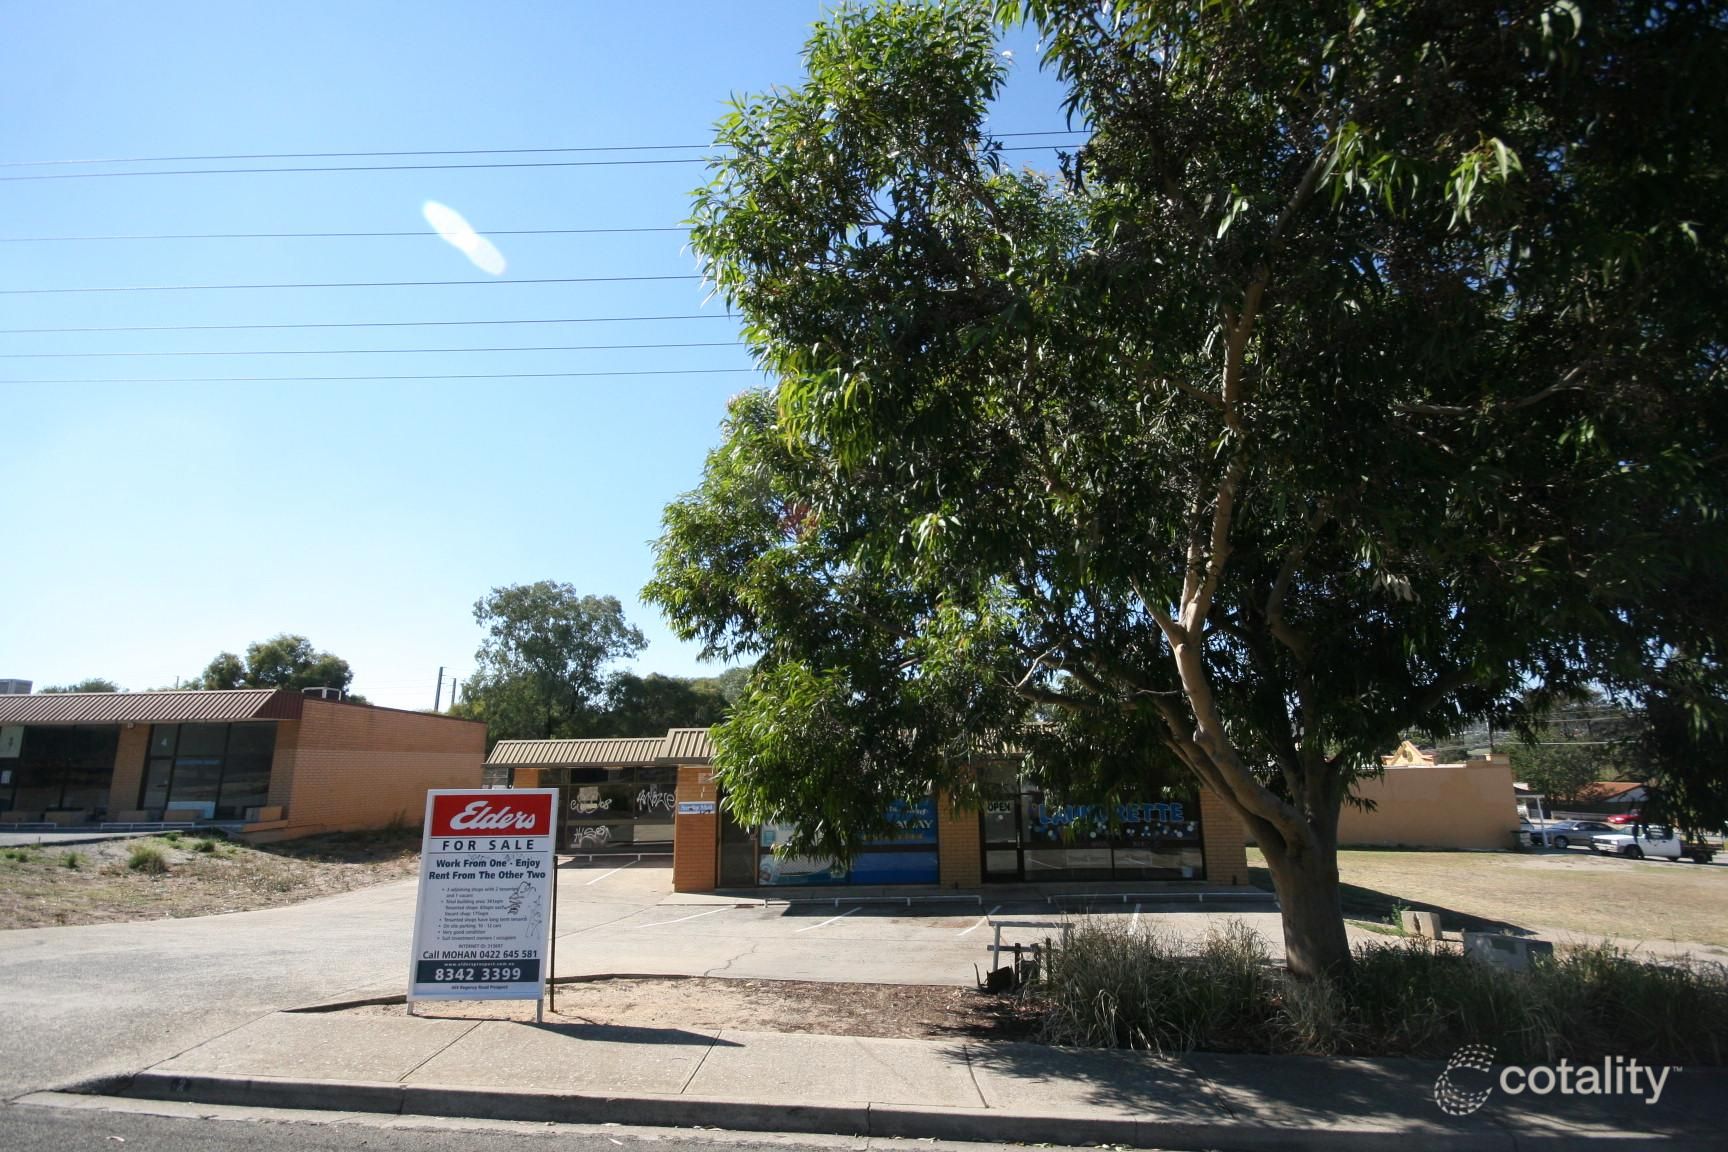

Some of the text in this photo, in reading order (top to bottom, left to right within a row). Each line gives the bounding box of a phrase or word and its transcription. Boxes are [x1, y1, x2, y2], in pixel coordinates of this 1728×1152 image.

[987, 802, 1010, 812] OPEN
[450, 800, 536, 830] Elders
[443, 839, 534, 851] FOR SALE
[436, 859, 461, 868] Work
[463, 858, 487, 868] From
[489, 858, 507, 867] One
[515, 858, 540, 869] Enjoy
[428, 870, 546, 880] Rent From The Other Two
[423, 949, 537, 959] Call MOHAN 0422 645 581
[434, 967, 521, 981] 8342 3399
